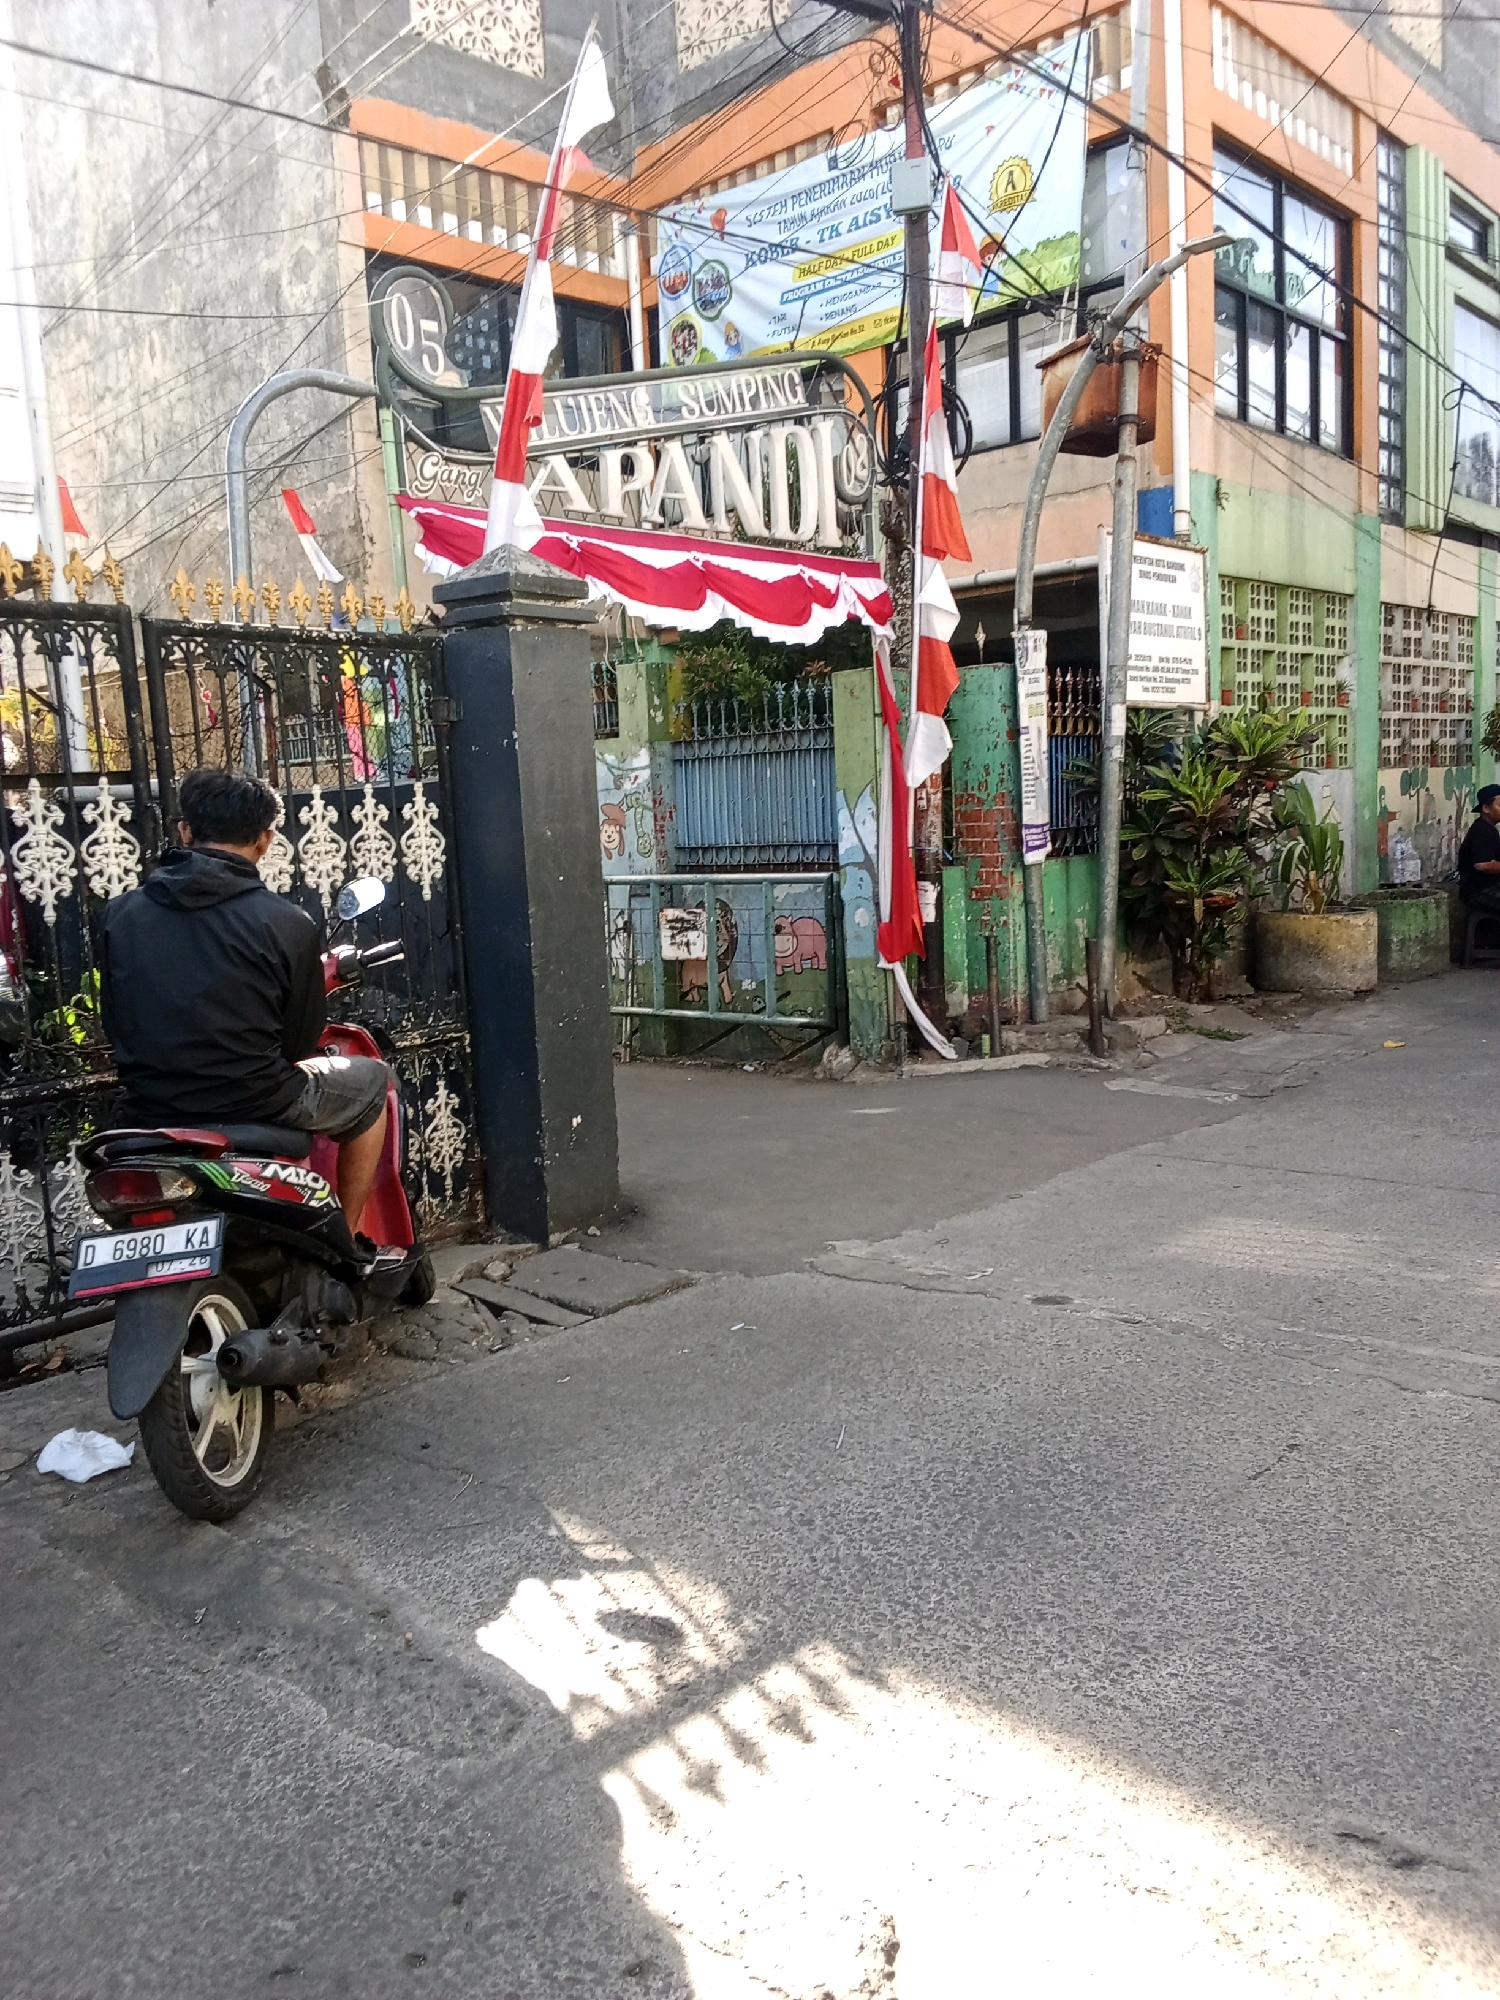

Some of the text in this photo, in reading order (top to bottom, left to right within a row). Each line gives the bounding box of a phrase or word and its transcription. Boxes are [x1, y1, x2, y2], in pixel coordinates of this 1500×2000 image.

[1004, 170, 1016, 193] A
[744, 236, 800, 270] KOBER
[817, 220, 844, 244] TK
[847, 202, 893, 233] AISY
[798, 260, 824, 278] HALF
[852, 242, 874, 262] FULL
[876, 235, 898, 252] DAY
[391, 294, 445, 376] 05
[482, 368, 807, 442] LUJENG SUMPING
[412, 452, 483, 503] Gang
[259, 1163, 326, 1190] MIO
[83, 1226, 210, 1267] D 6980 KA
